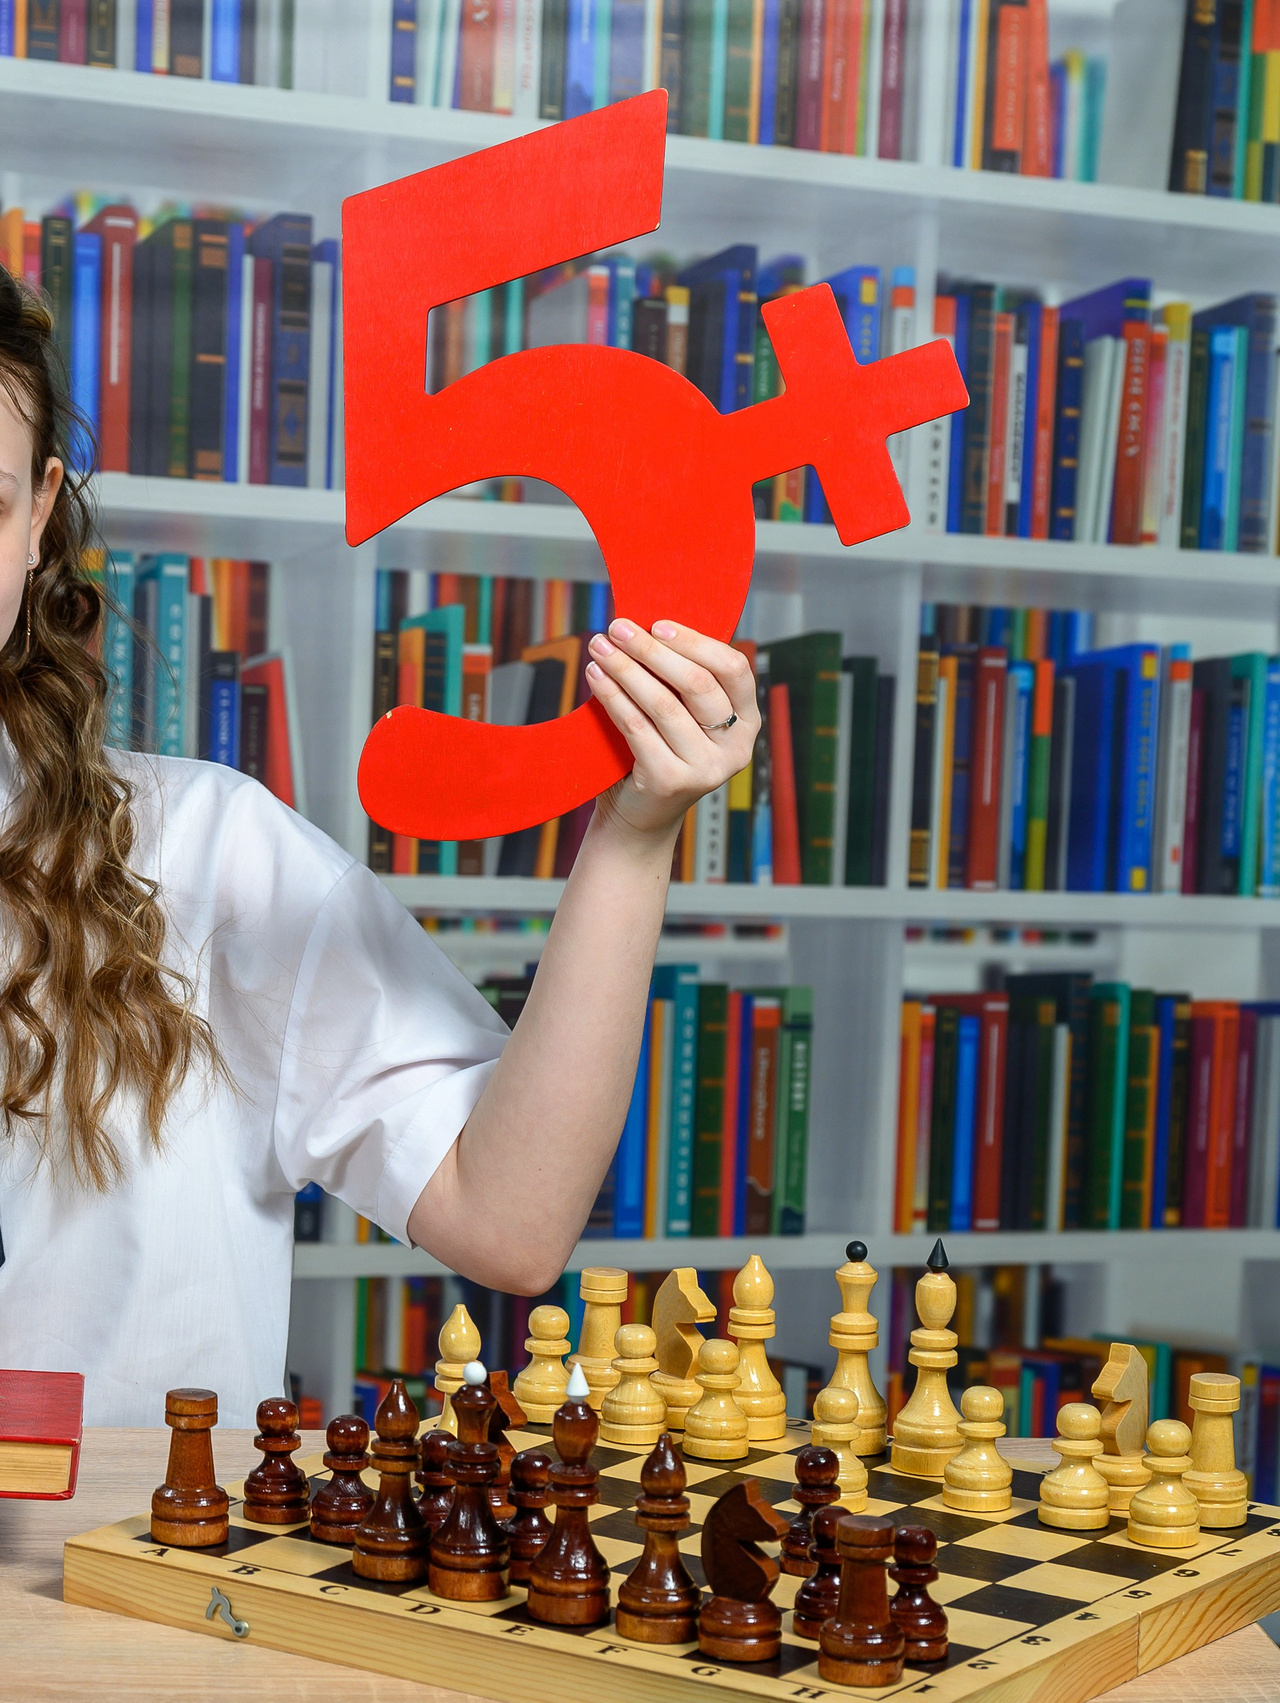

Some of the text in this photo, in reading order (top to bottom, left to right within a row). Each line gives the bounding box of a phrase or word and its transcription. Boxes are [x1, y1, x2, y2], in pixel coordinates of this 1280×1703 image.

[341, 88, 970, 841] 5+
[141, 1547, 829, 1700] A B C D E F G H
[913, 1548, 1243, 1694] 1 2 3 4 5 6 7
